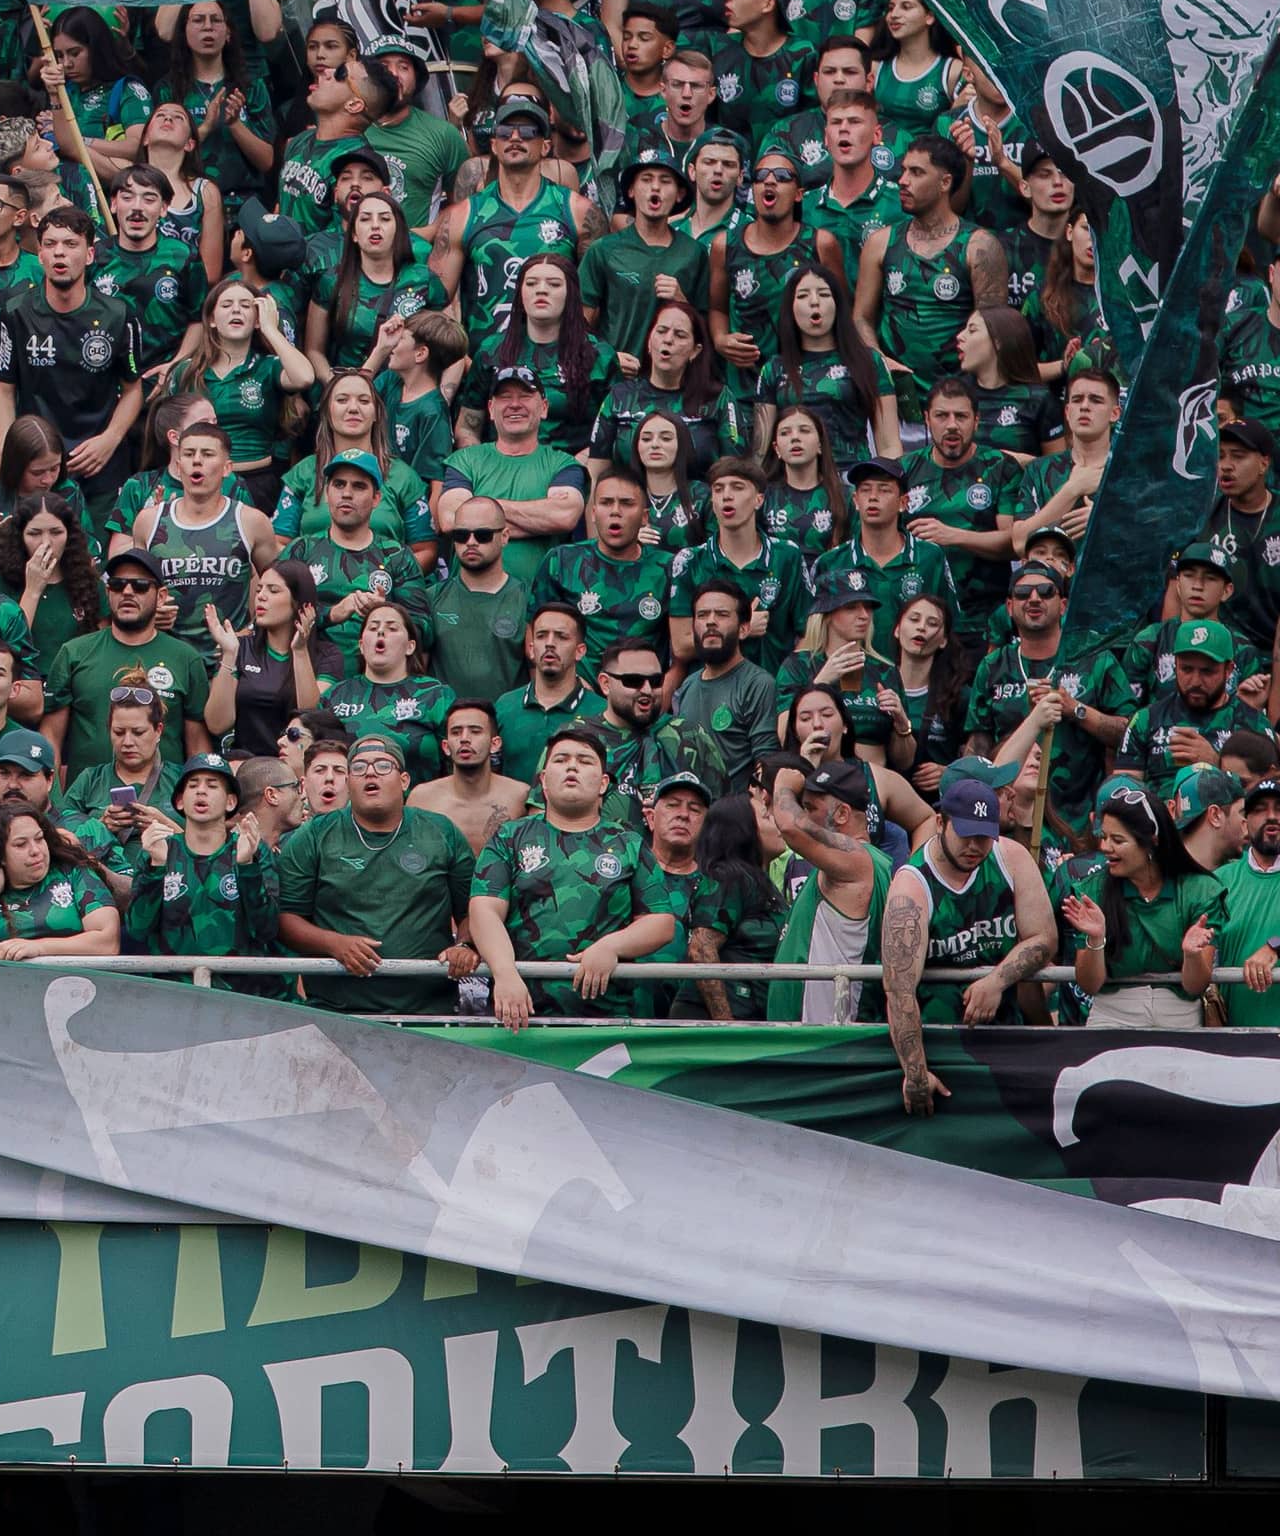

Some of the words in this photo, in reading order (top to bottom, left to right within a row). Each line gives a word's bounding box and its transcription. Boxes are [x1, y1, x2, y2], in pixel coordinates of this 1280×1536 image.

[25, 334, 57, 357] 44
[199, 576, 224, 587] 1977
[973, 800, 989, 817] NY
[928, 913, 1017, 959] IMPRIO
